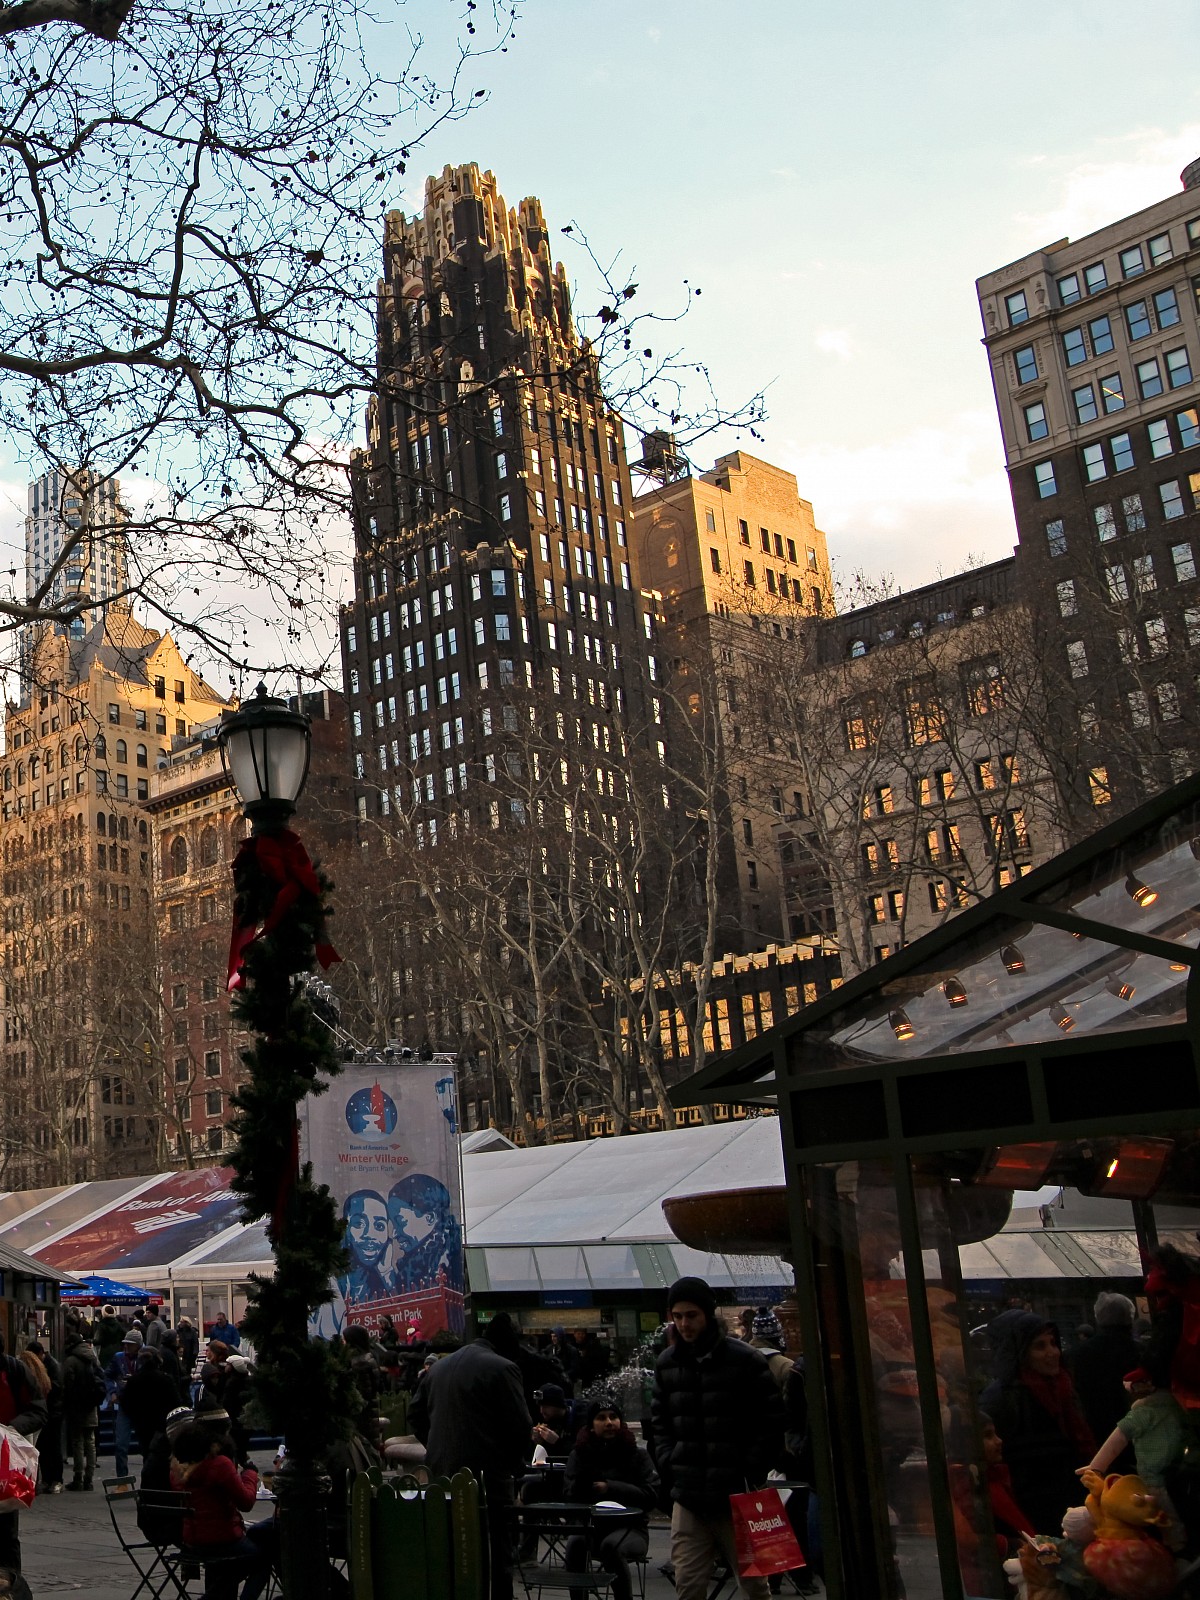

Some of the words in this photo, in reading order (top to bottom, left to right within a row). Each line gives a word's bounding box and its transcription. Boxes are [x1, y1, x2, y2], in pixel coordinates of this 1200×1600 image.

[338, 1154, 373, 1163] Winter
[375, 1154, 408, 1165] Village
[359, 1165, 379, 1173] Bryant
[116, 1196, 174, 1212] Bank
[404, 1308, 422, 1321] Park
